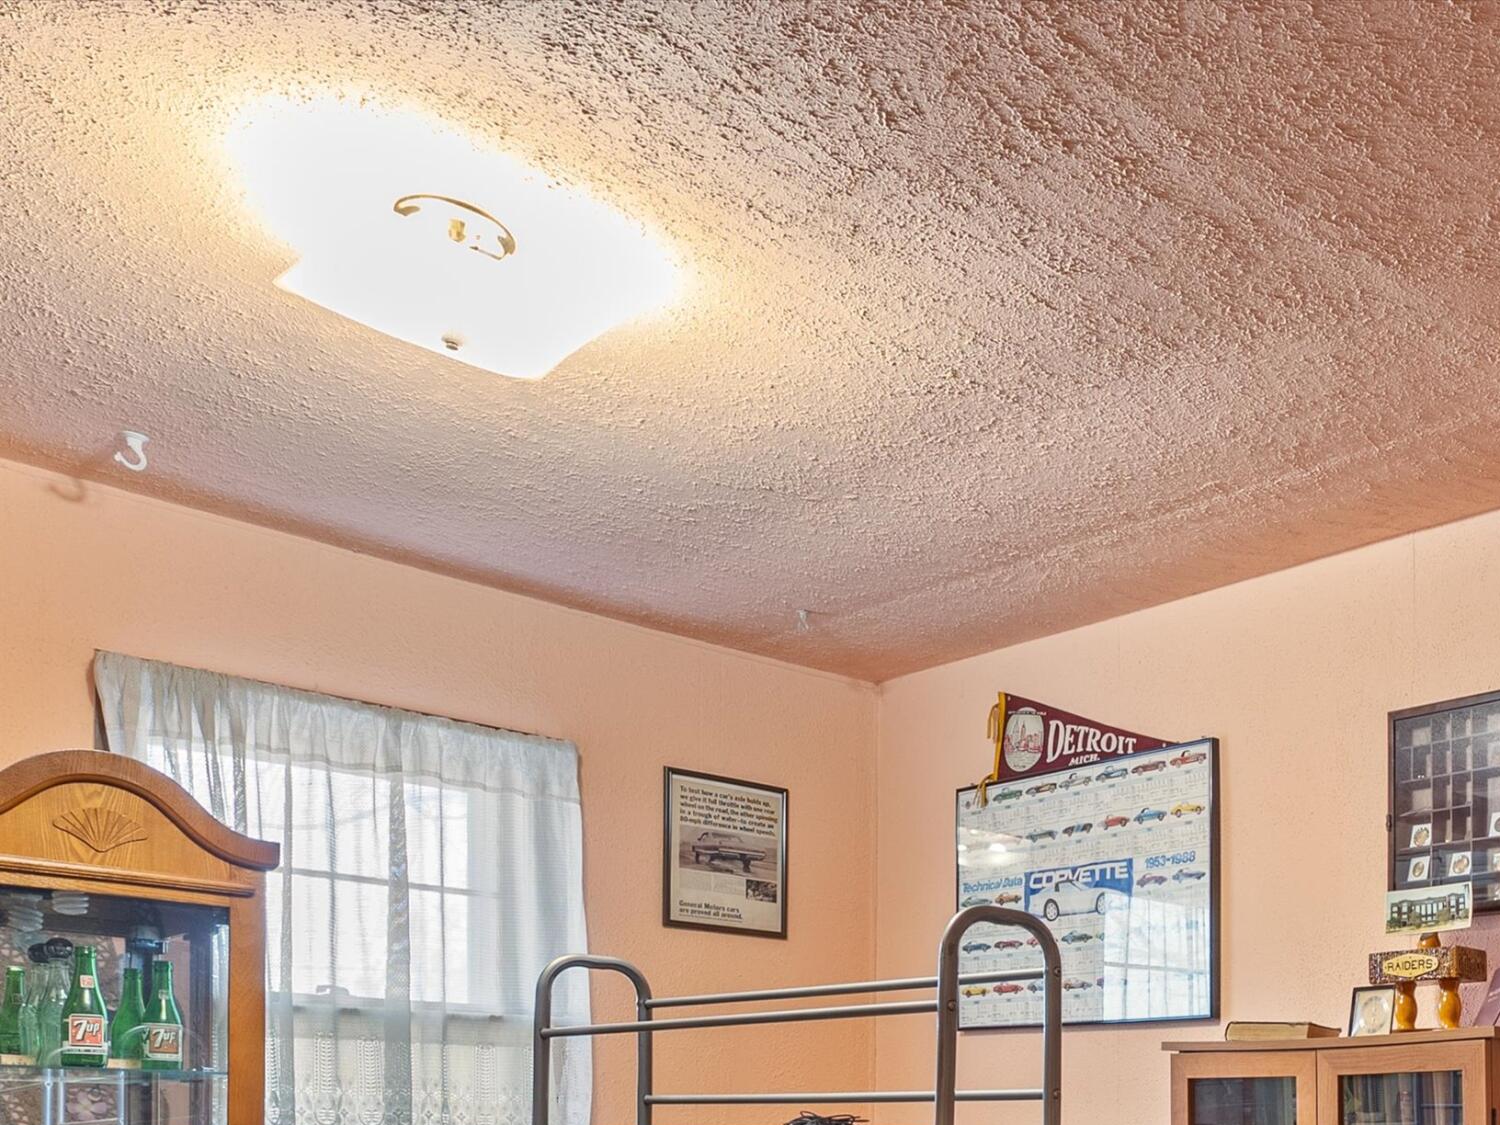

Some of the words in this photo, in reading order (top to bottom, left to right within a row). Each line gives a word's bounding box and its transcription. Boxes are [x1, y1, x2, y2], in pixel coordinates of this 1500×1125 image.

[1046, 719, 1137, 763] DETROIT
[1068, 753, 1101, 767] MICH.
[1144, 851, 1196, 869] 1953-1988
[1386, 958, 1433, 971] RAIDERS
